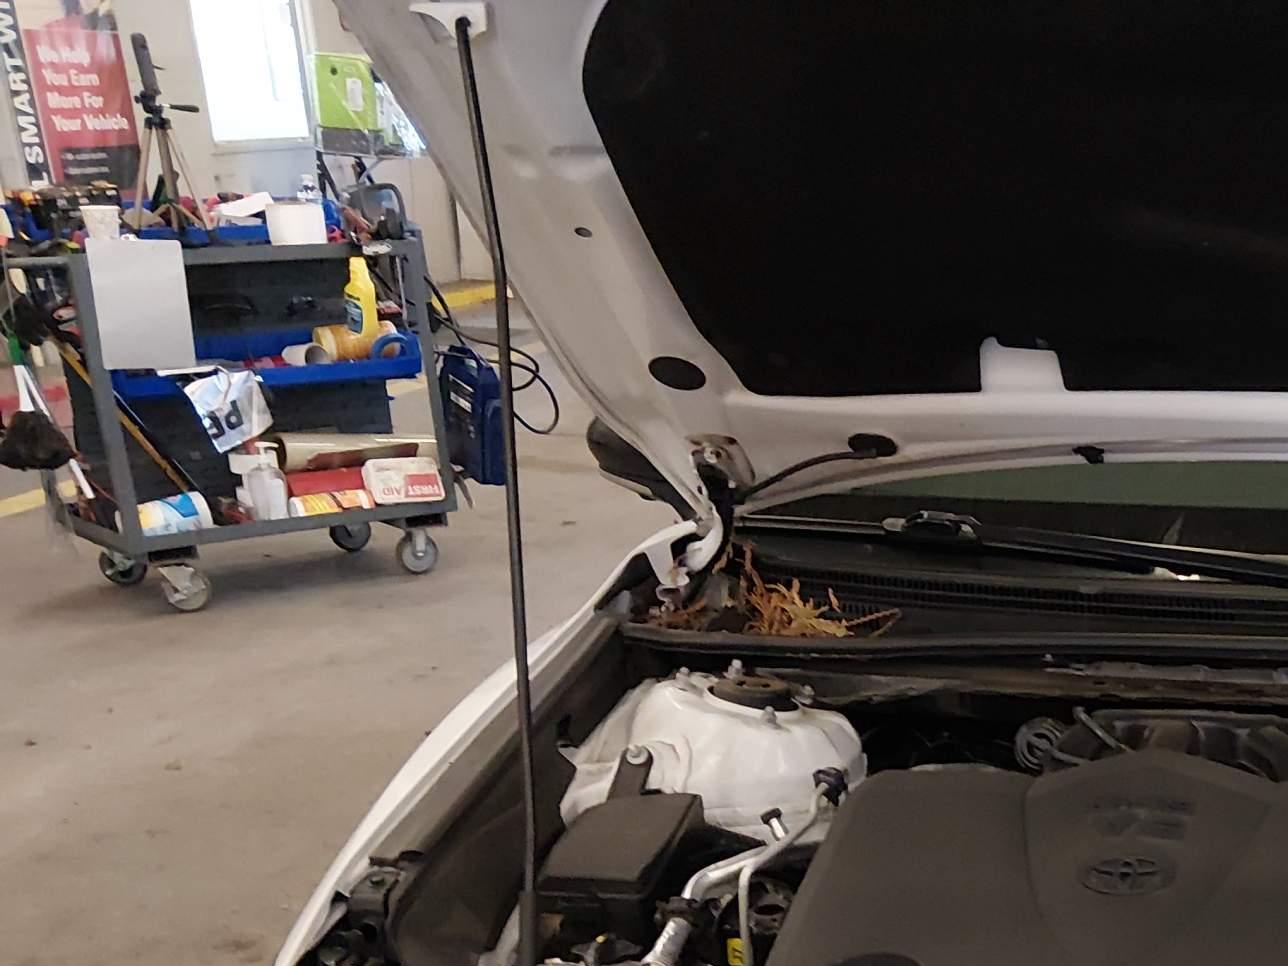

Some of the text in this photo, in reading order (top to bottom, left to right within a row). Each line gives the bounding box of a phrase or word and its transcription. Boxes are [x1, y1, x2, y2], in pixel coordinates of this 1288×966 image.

[42, 69, 100, 87] You Earn
[3, 51, 45, 164] SMART
[46, 91, 104, 109] More For
[51, 113, 129, 131] Your Vehicle
[382, 484, 441, 497] FIRST AID
